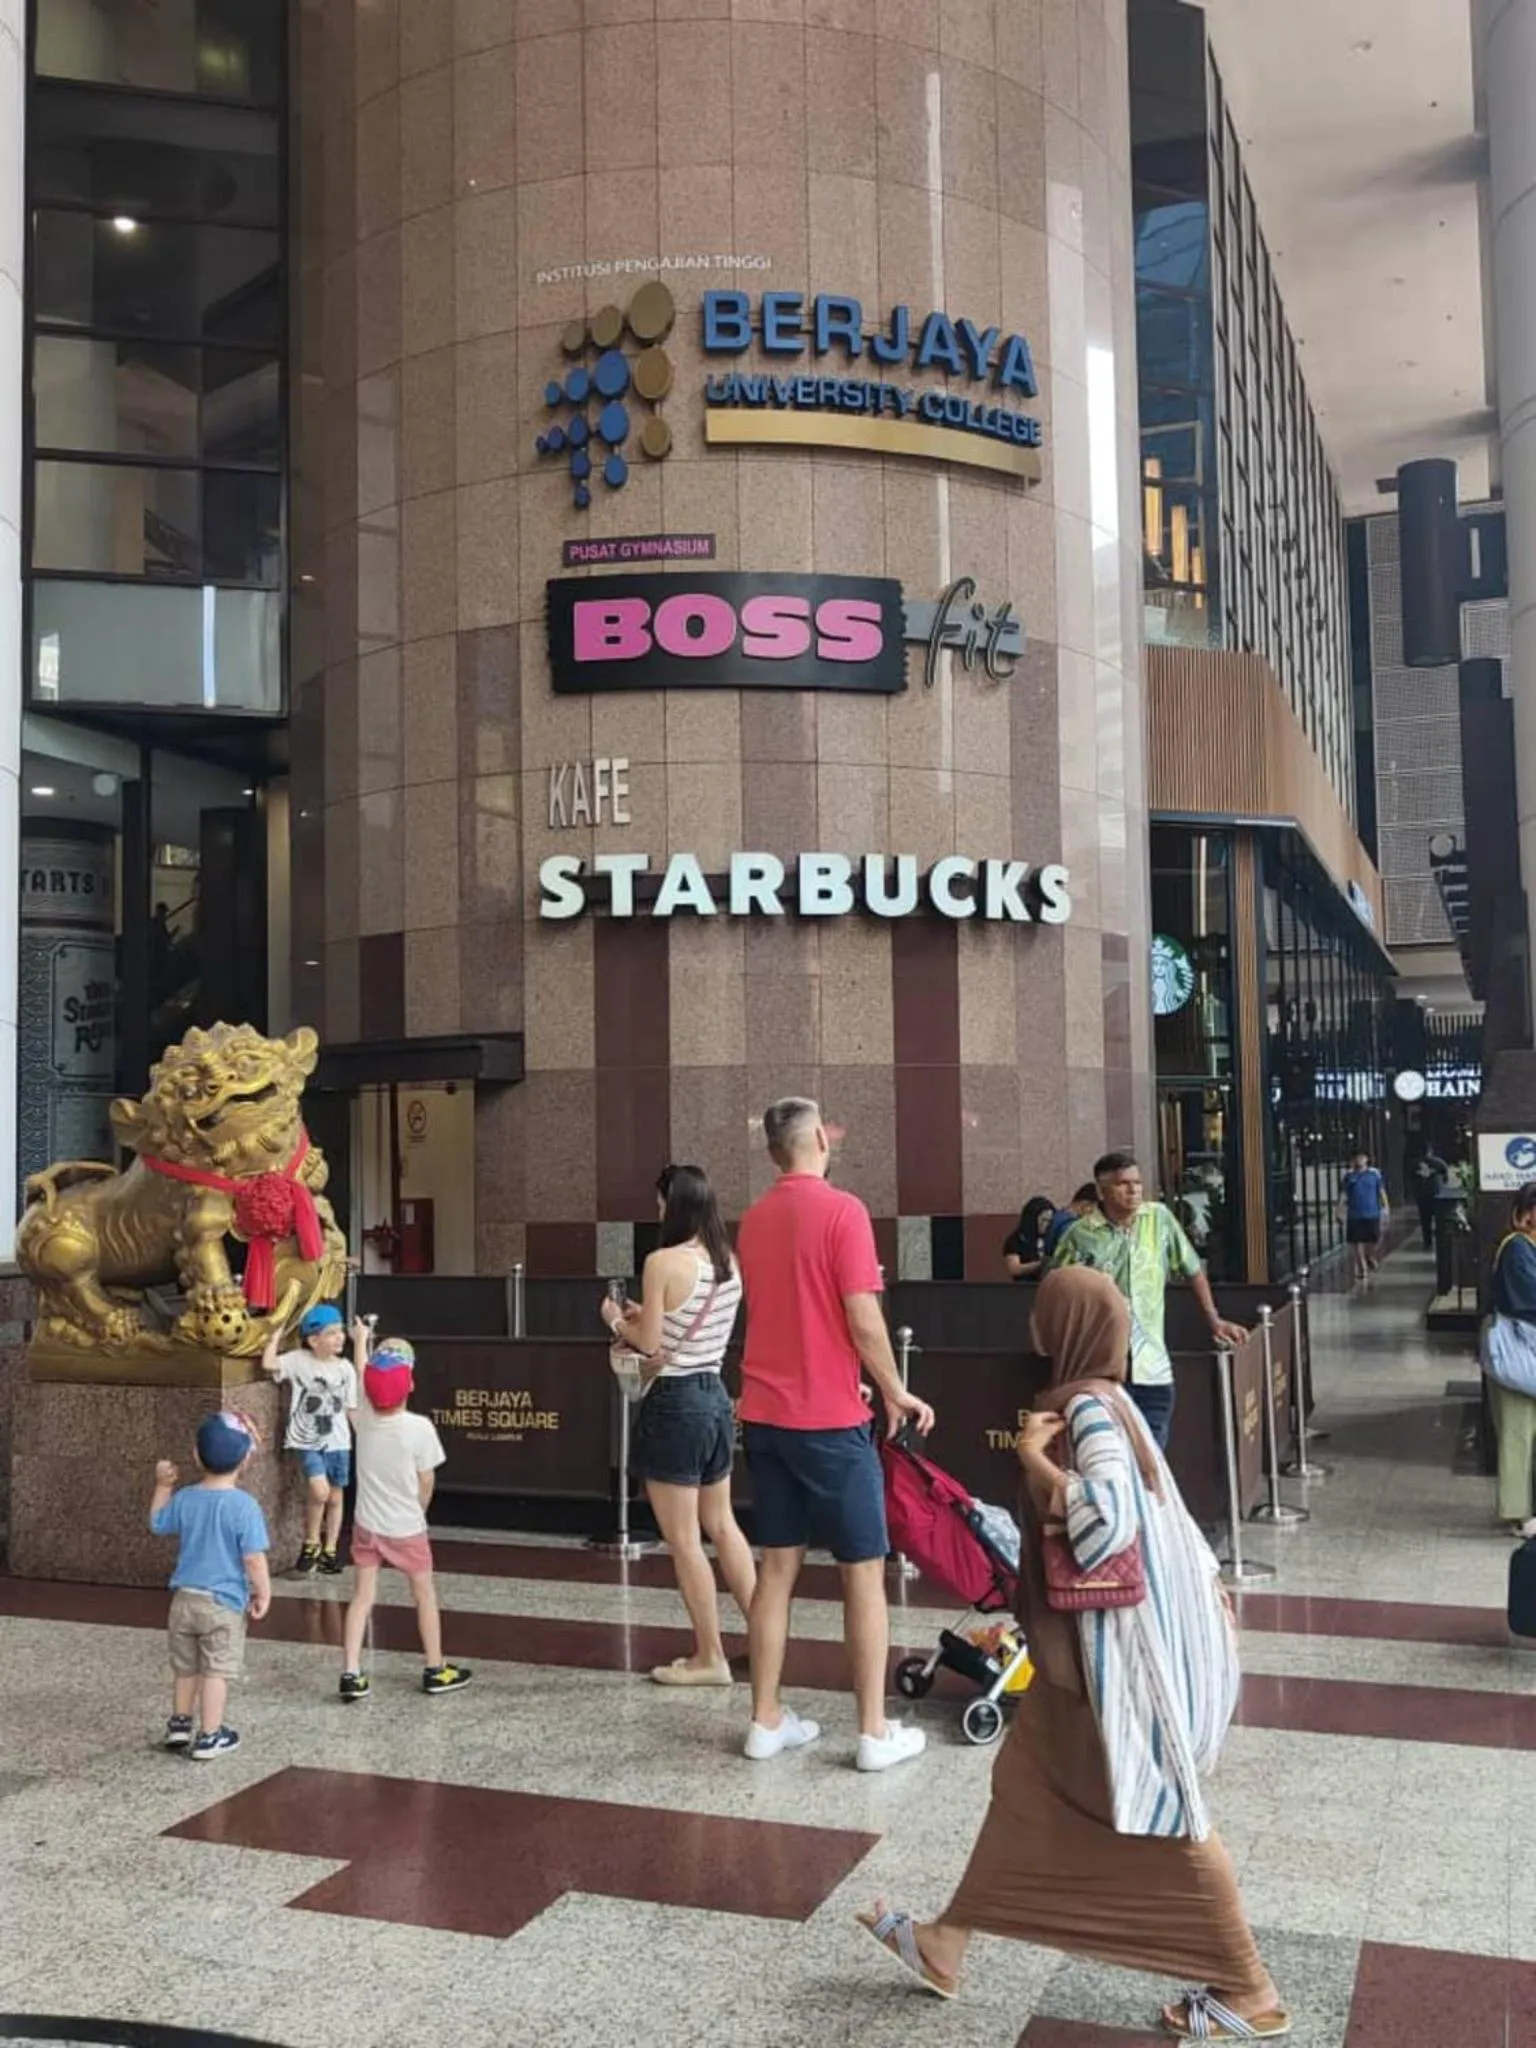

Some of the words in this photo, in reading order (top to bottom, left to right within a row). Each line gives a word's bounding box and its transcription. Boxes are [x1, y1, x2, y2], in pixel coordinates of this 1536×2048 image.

[536, 261, 612, 284] INSTITUSI
[614, 255, 709, 275] PENGAJIAN
[715, 254, 772, 270] TINGGI
[703, 289, 1039, 399] BERJAYA
[705, 372, 916, 418] UNIVERSITY
[920, 387, 1043, 448] COLLEGE
[569, 543, 617, 560] PUSAT
[620, 539, 710, 557] GYMNASIUM
[572, 593, 885, 663] BOSS
[924, 577, 1019, 689] fit
[548, 756, 631, 829] KAFE
[538, 852, 1073, 925] STARBUCKS
[431, 1408, 483, 1428] TIMES
[487, 1410, 560, 1430] SQUARE
[455, 1388, 534, 1409] BERJAYA
[985, 1429, 1022, 1451] TIM
